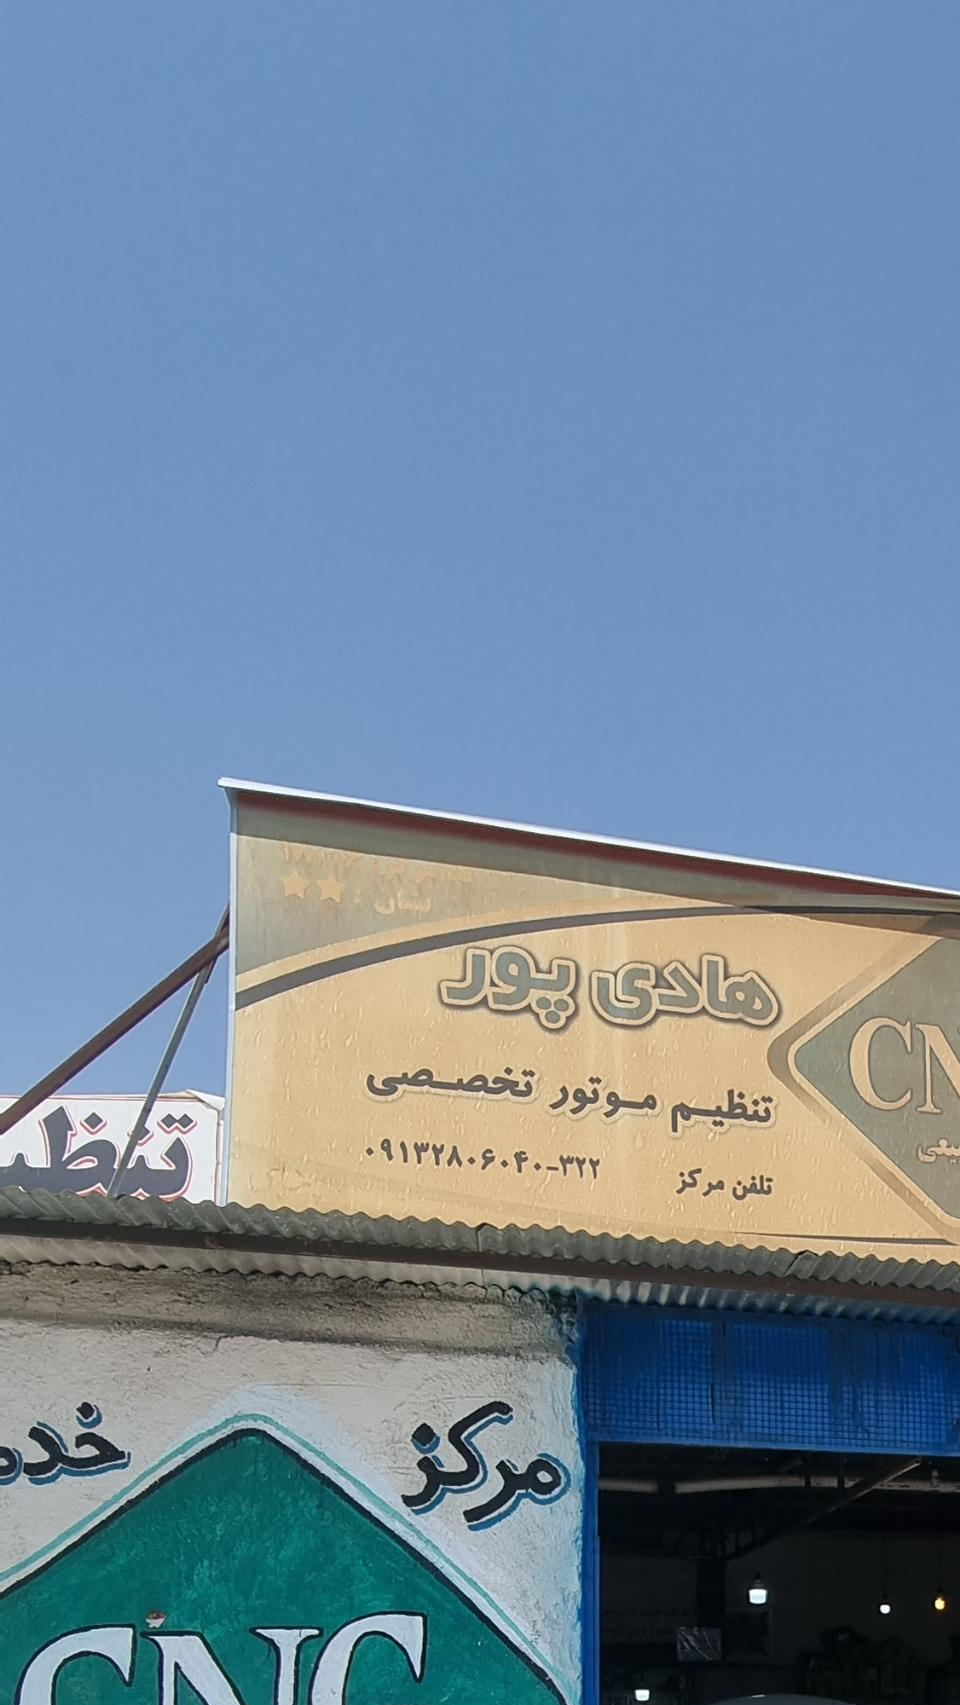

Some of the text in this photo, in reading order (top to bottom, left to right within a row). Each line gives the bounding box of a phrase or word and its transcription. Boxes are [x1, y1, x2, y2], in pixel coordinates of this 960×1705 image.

[440, 945, 780, 1031] هادی پور
[365, 1067, 773, 1133] تنظیم موتور تخصصی
[676, 1167, 774, 1201] تلفن مرکز
[402, 1401, 571, 1530] مرکز
